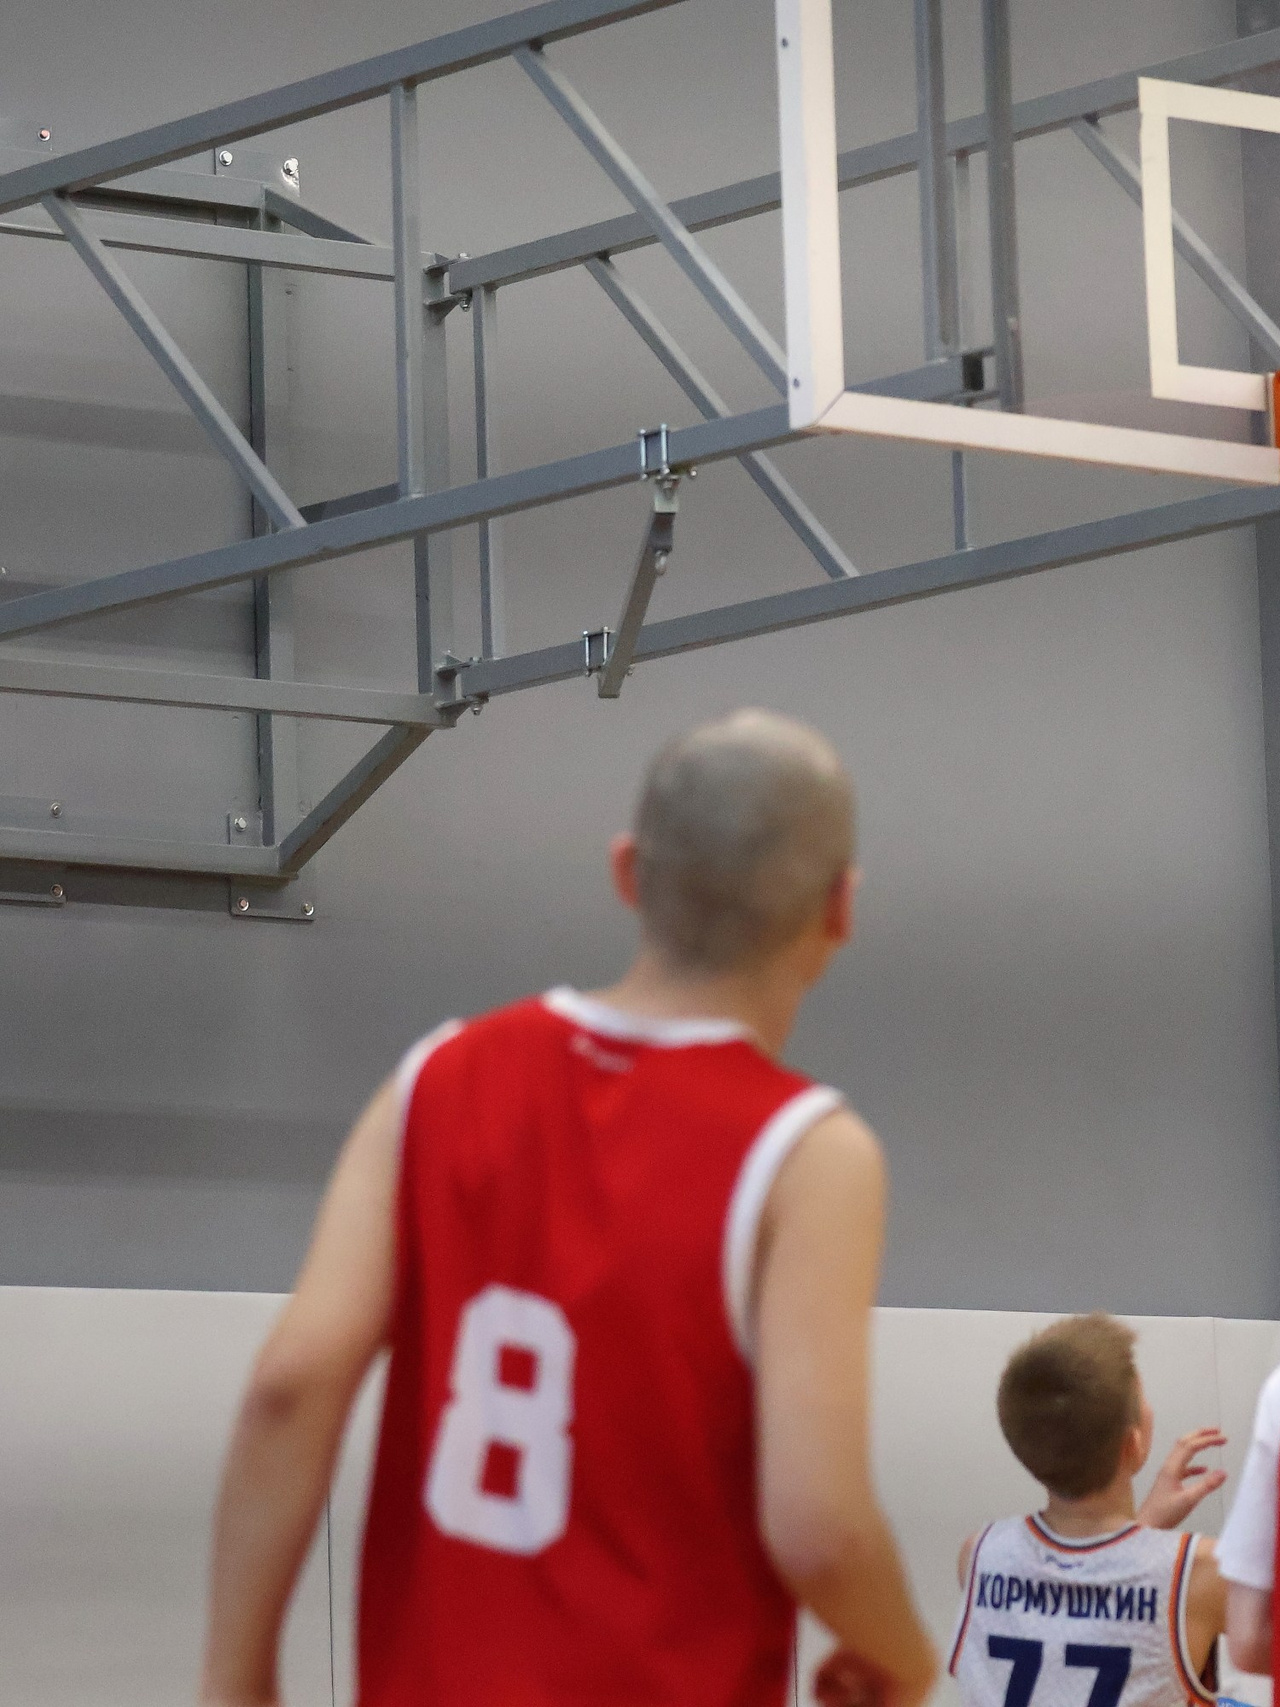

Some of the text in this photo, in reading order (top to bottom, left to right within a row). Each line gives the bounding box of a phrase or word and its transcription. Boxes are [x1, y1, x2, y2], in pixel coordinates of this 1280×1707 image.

[424, 1284, 577, 1556] 8
[977, 1573, 1157, 1623] КОРМУШКИН
[987, 1634, 1132, 1707] 77
